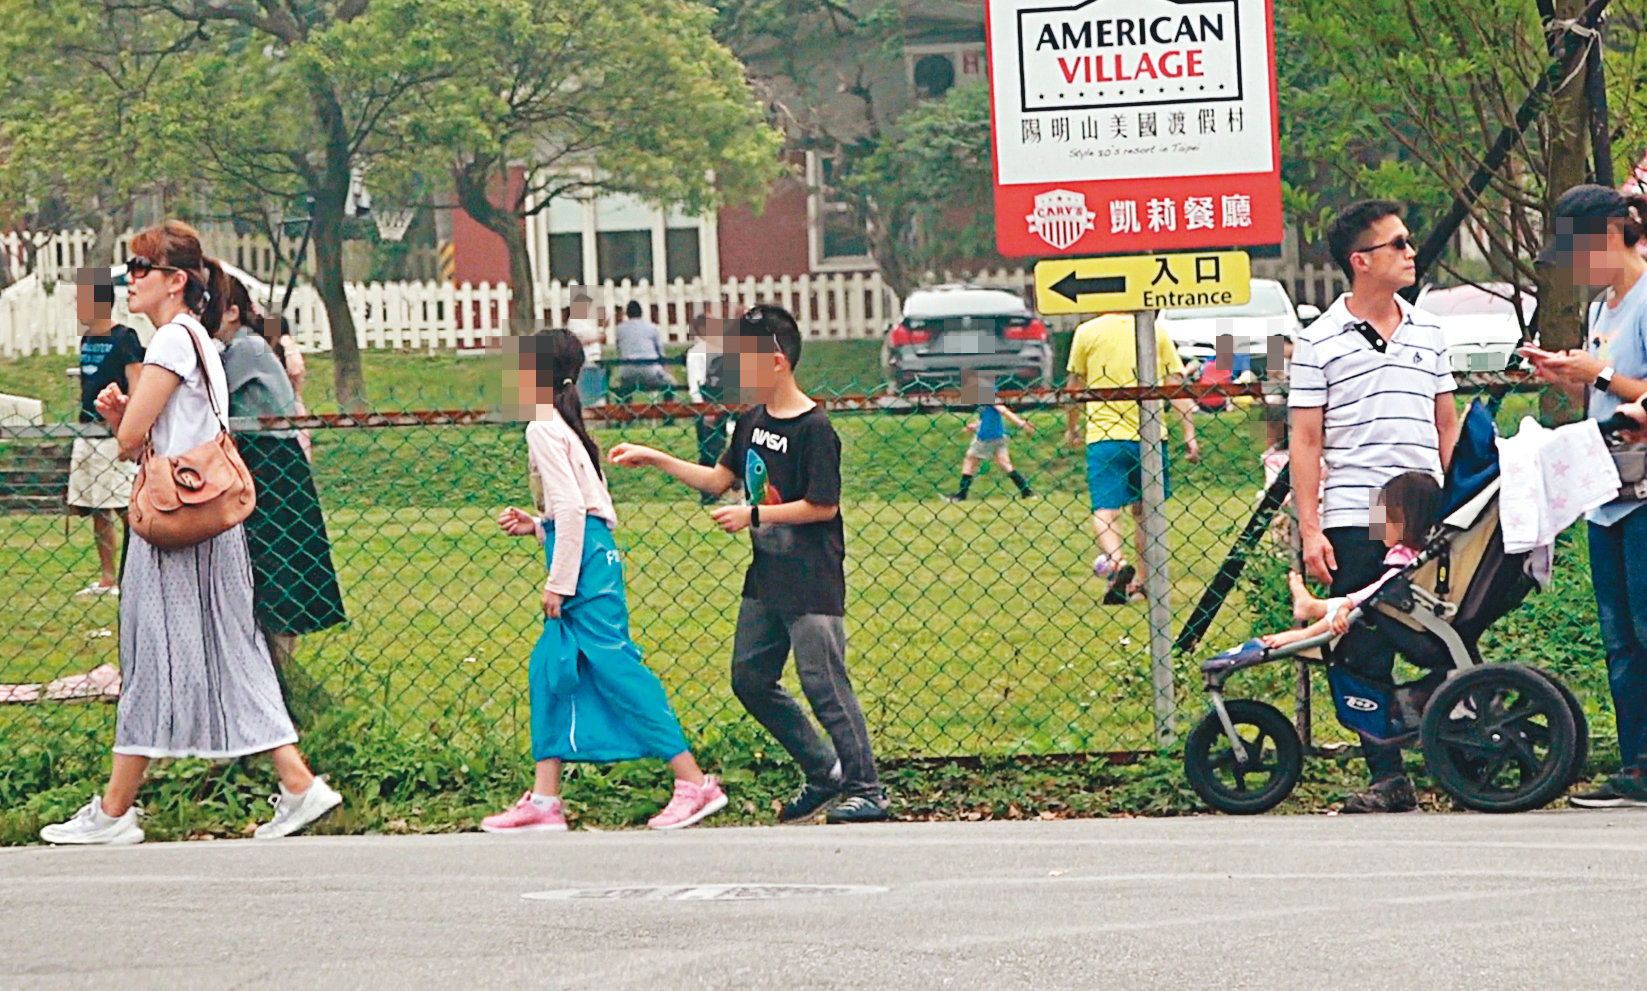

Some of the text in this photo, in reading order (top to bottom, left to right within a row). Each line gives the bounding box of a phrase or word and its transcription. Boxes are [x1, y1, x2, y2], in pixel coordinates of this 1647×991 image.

[1036, 14, 1224, 51] AMERICAN
[1057, 50, 1205, 84] VILLAGE
[1020, 107, 1245, 145] 陽明山美國渡假村
[1068, 148, 1094, 160] Style
[1123, 145, 1156, 155] resort
[1159, 145, 1168, 153] in
[1171, 142, 1200, 154] Taipei
[1109, 194, 1252, 233] 凱莉餐廳
[1151, 256, 1221, 287] 入口
[1143, 289, 1232, 308] Entrance
[751, 427, 788, 454] NASA
